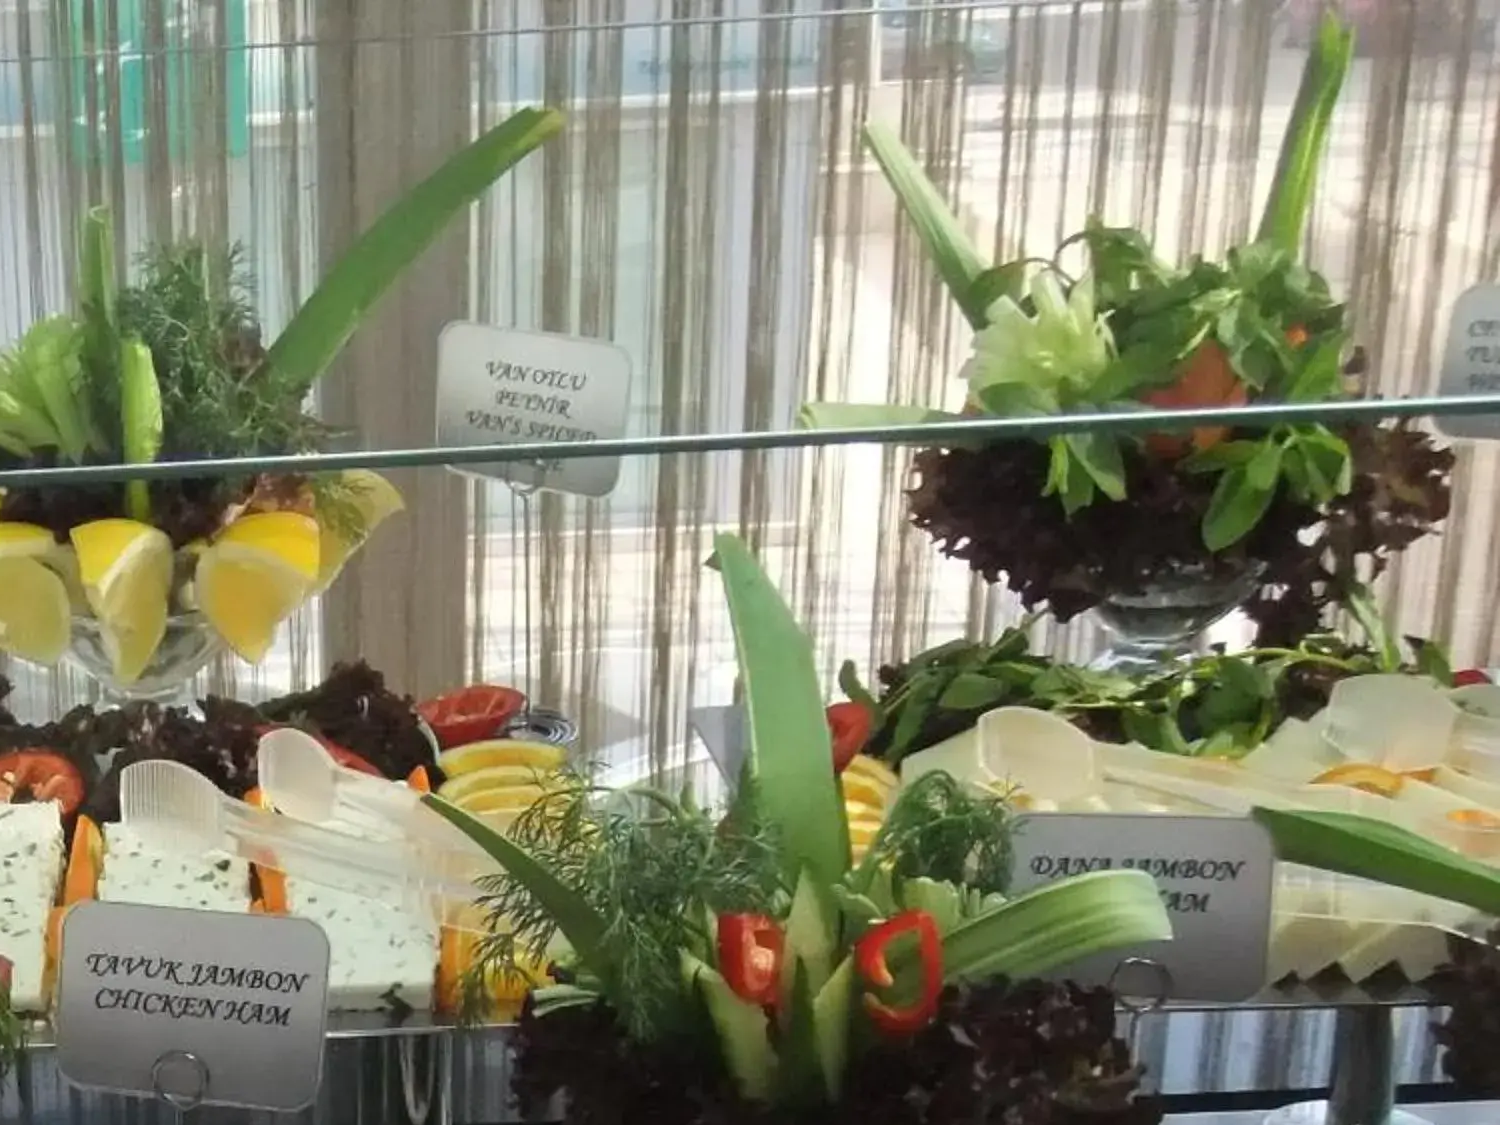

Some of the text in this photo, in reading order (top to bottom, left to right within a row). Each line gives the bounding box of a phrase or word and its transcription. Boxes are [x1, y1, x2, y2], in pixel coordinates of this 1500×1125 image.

[486, 359, 530, 381] VAN
[1158, 888, 1210, 912] AM
[85, 953, 309, 993] TAVUK JAMBON
[95, 987, 292, 1026] CHICKEN HAM
